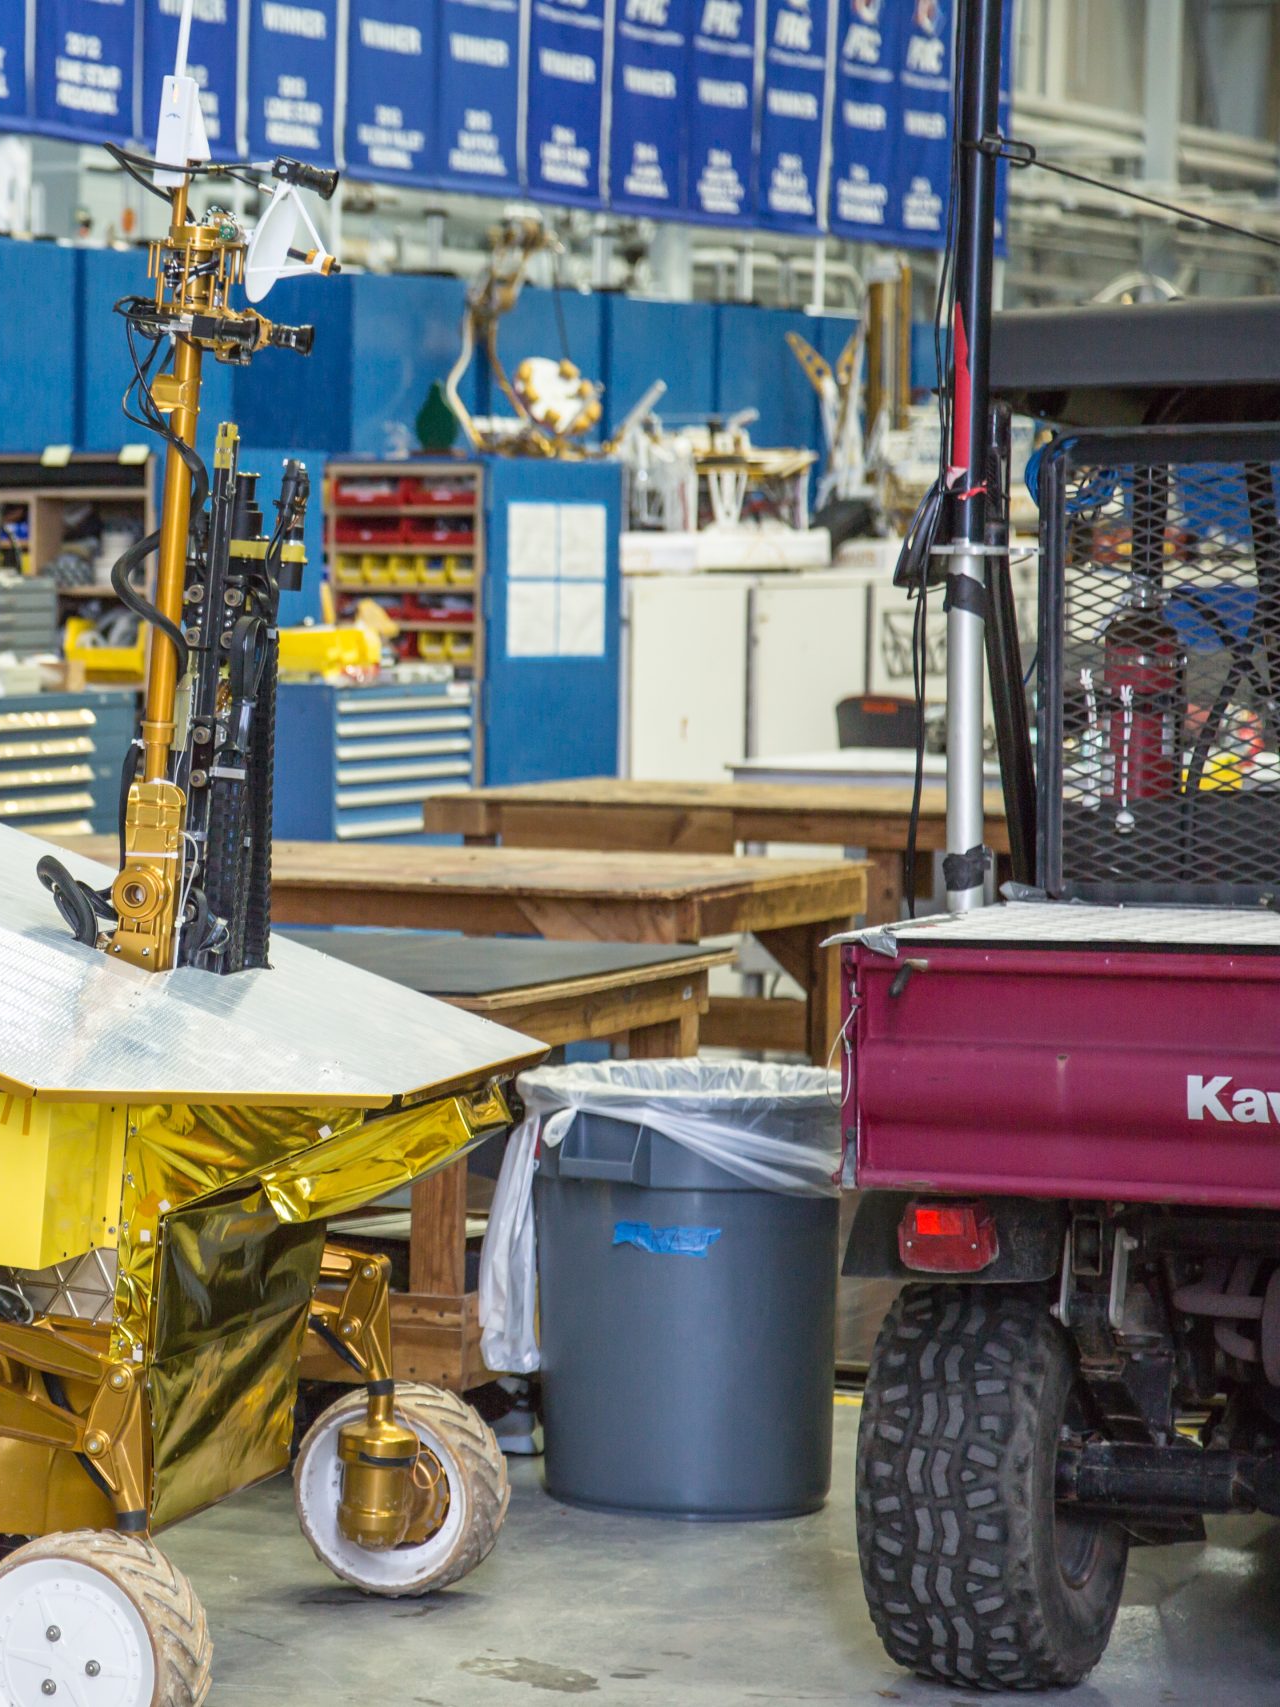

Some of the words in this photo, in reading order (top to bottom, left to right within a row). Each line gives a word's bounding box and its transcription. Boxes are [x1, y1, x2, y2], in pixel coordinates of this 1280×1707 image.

[262, 2, 326, 40] WINNER
[360, 18, 422, 56] WINNER
[449, 32, 510, 68] WINNER
[539, 48, 596, 84] WINNER
[623, 65, 677, 99] WINNER
[698, 77, 748, 110] WINNER
[767, 87, 818, 121] WINNER
